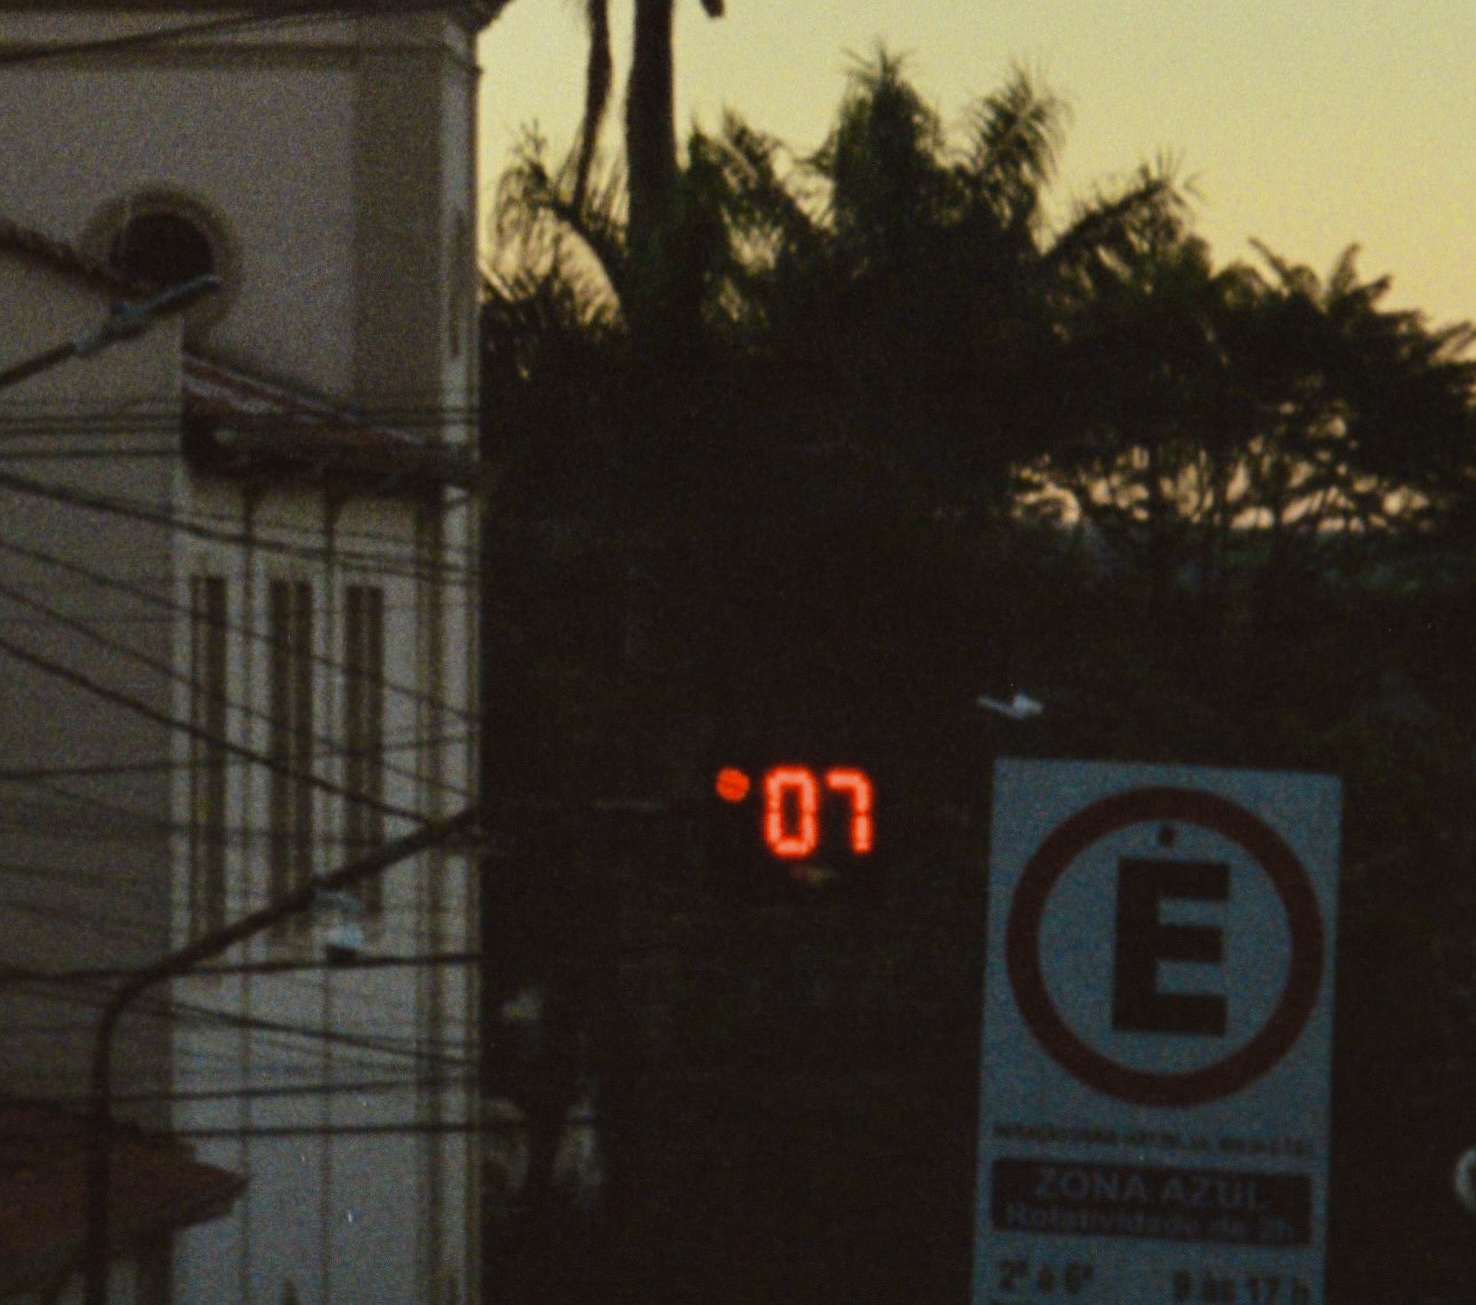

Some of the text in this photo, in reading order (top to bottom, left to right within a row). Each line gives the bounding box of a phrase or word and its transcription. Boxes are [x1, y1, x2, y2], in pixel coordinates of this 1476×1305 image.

[762, 764, 876, 859] 07
[1113, 859, 1230, 1035] E
[1036, 1166, 1269, 1211] ZONA AZUL
